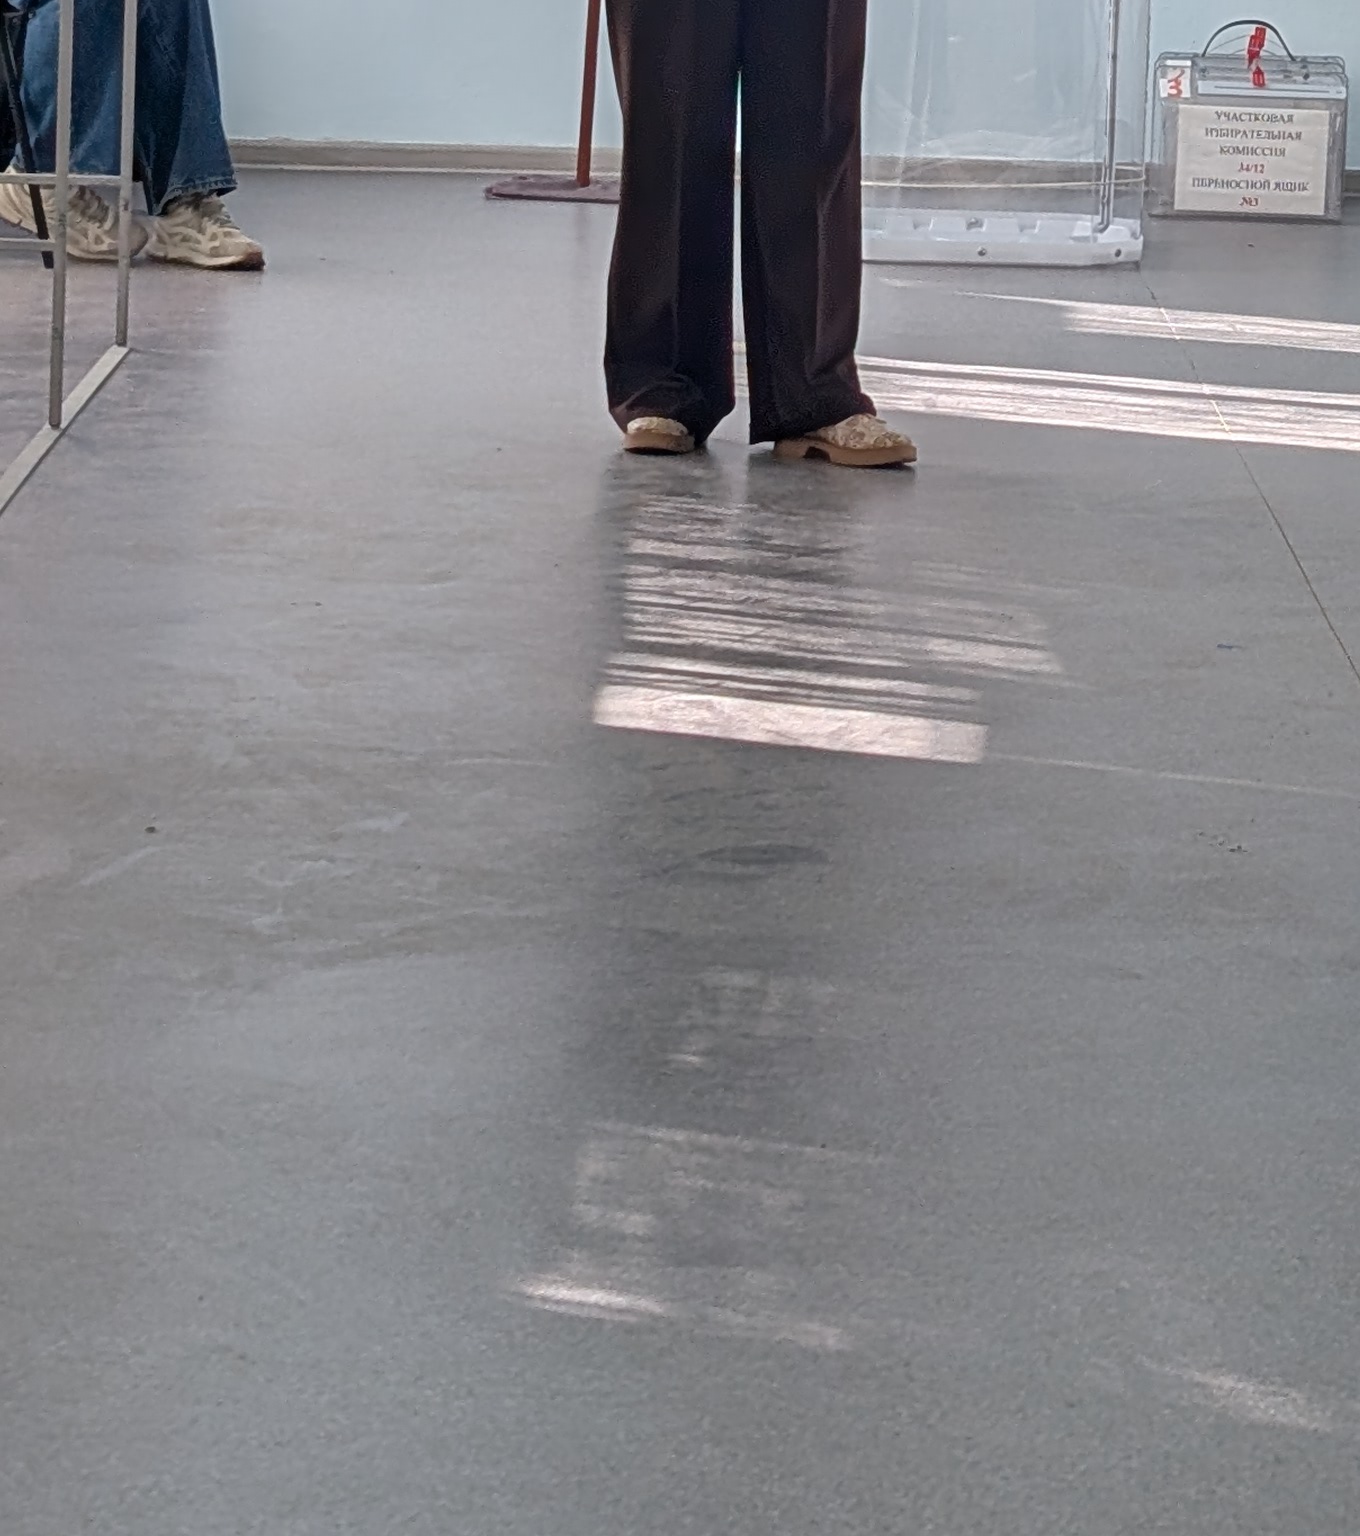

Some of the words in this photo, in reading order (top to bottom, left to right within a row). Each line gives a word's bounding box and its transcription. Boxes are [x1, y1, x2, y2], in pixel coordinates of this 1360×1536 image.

[1214, 110, 1294, 125] УЧАСТКОВАЯ
[1204, 127, 1303, 141] ИЗБИРАТЕЛЬНАЯ
[1218, 144, 1287, 158] КОМИССИЯ
[1191, 176, 1271, 192] ПЕРЕНОСНОЙ
[1272, 180, 1311, 193] ЯЩИК
